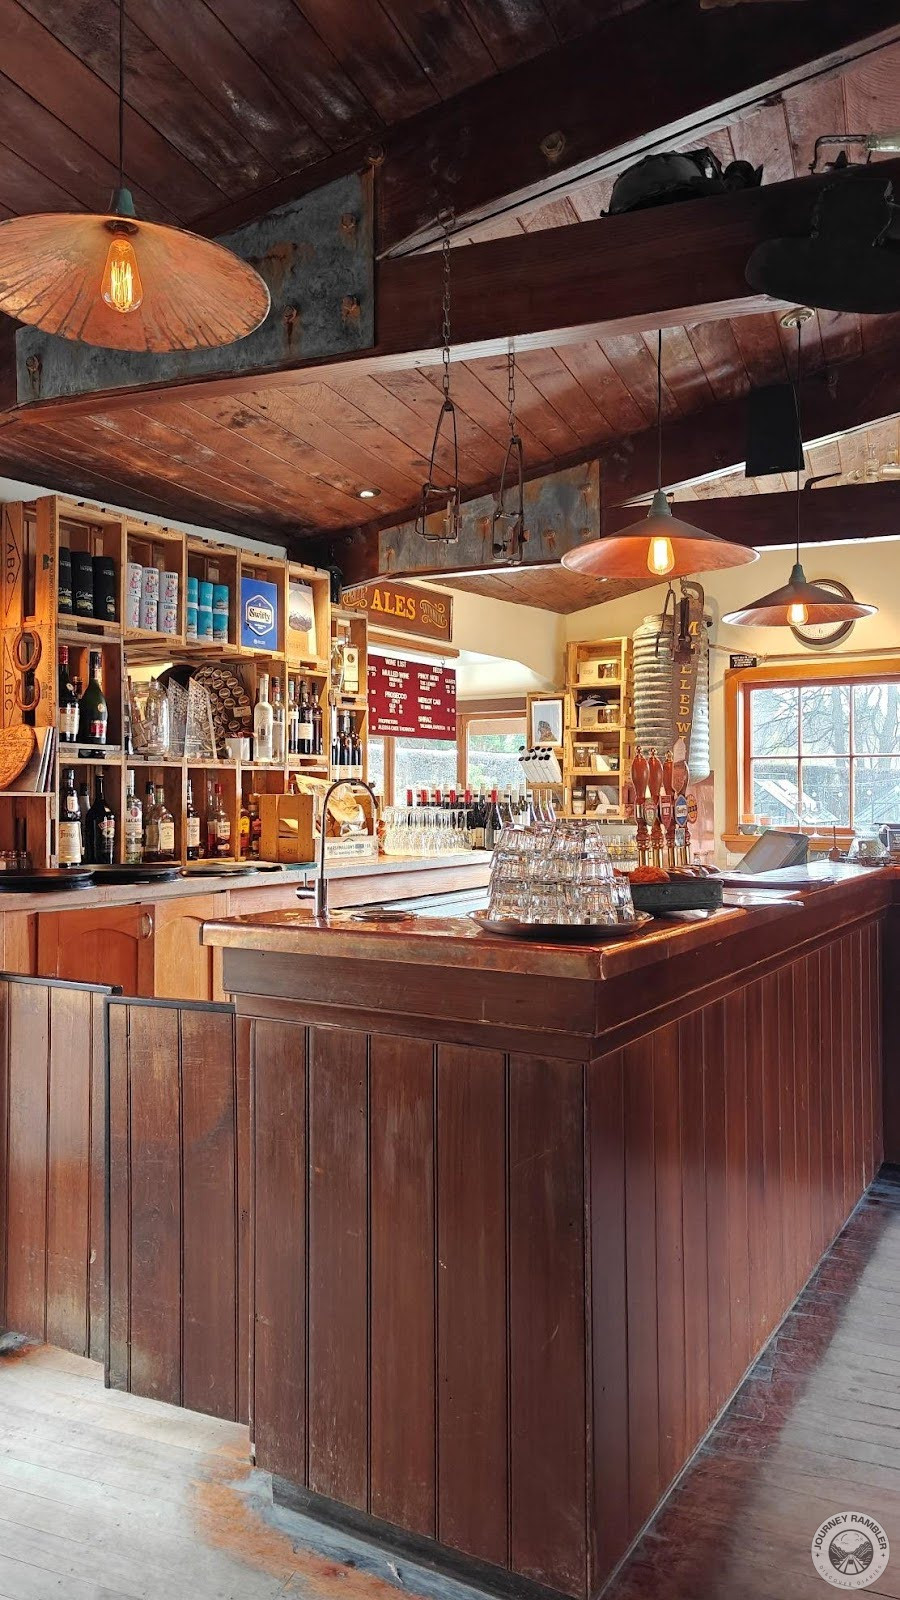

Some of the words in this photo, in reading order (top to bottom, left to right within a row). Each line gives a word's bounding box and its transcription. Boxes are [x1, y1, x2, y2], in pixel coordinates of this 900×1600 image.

[7, 543, 15, 584] ABC
[370, 588, 416, 620] ALES
[385, 658, 396, 667] WINE
[397, 660, 407, 668] LIST
[382, 669, 399, 678] MULLED
[399, 672, 410, 680] WINE
[418, 672, 430, 680] PINOT
[430, 674, 440, 682] NOIR
[5, 669, 14, 711] ABC
[385, 691, 408, 700] PROSECCO
[418, 696, 432, 705] MERLOT
